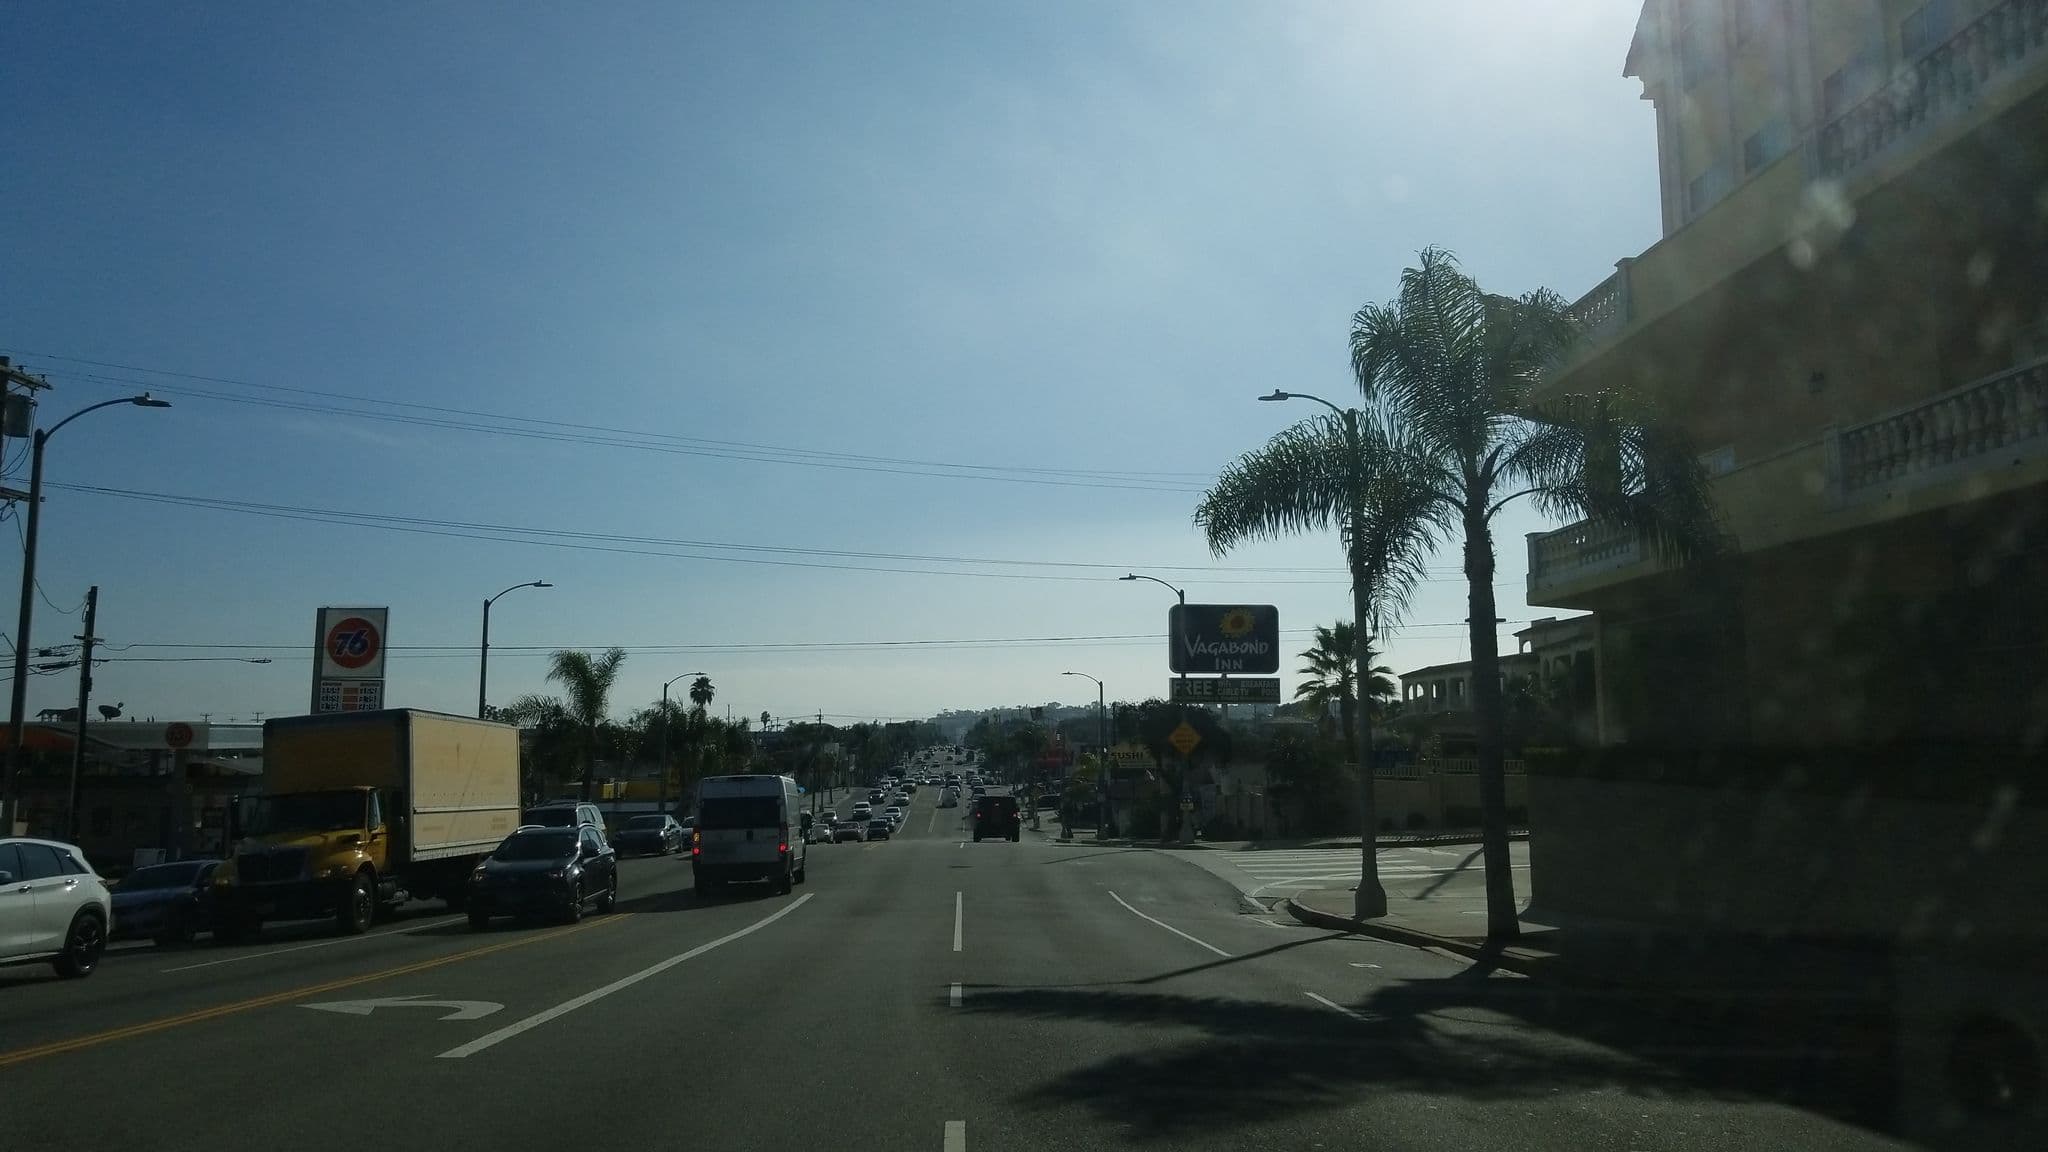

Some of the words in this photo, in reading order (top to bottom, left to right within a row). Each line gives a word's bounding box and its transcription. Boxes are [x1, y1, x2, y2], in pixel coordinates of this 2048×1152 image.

[335, 629, 369, 656] 76
[1184, 632, 1270, 657] VAGABOND
[1215, 657, 1242, 671] INN
[1173, 680, 1212, 696] FREE
[1111, 751, 1143, 760] SUSHI
